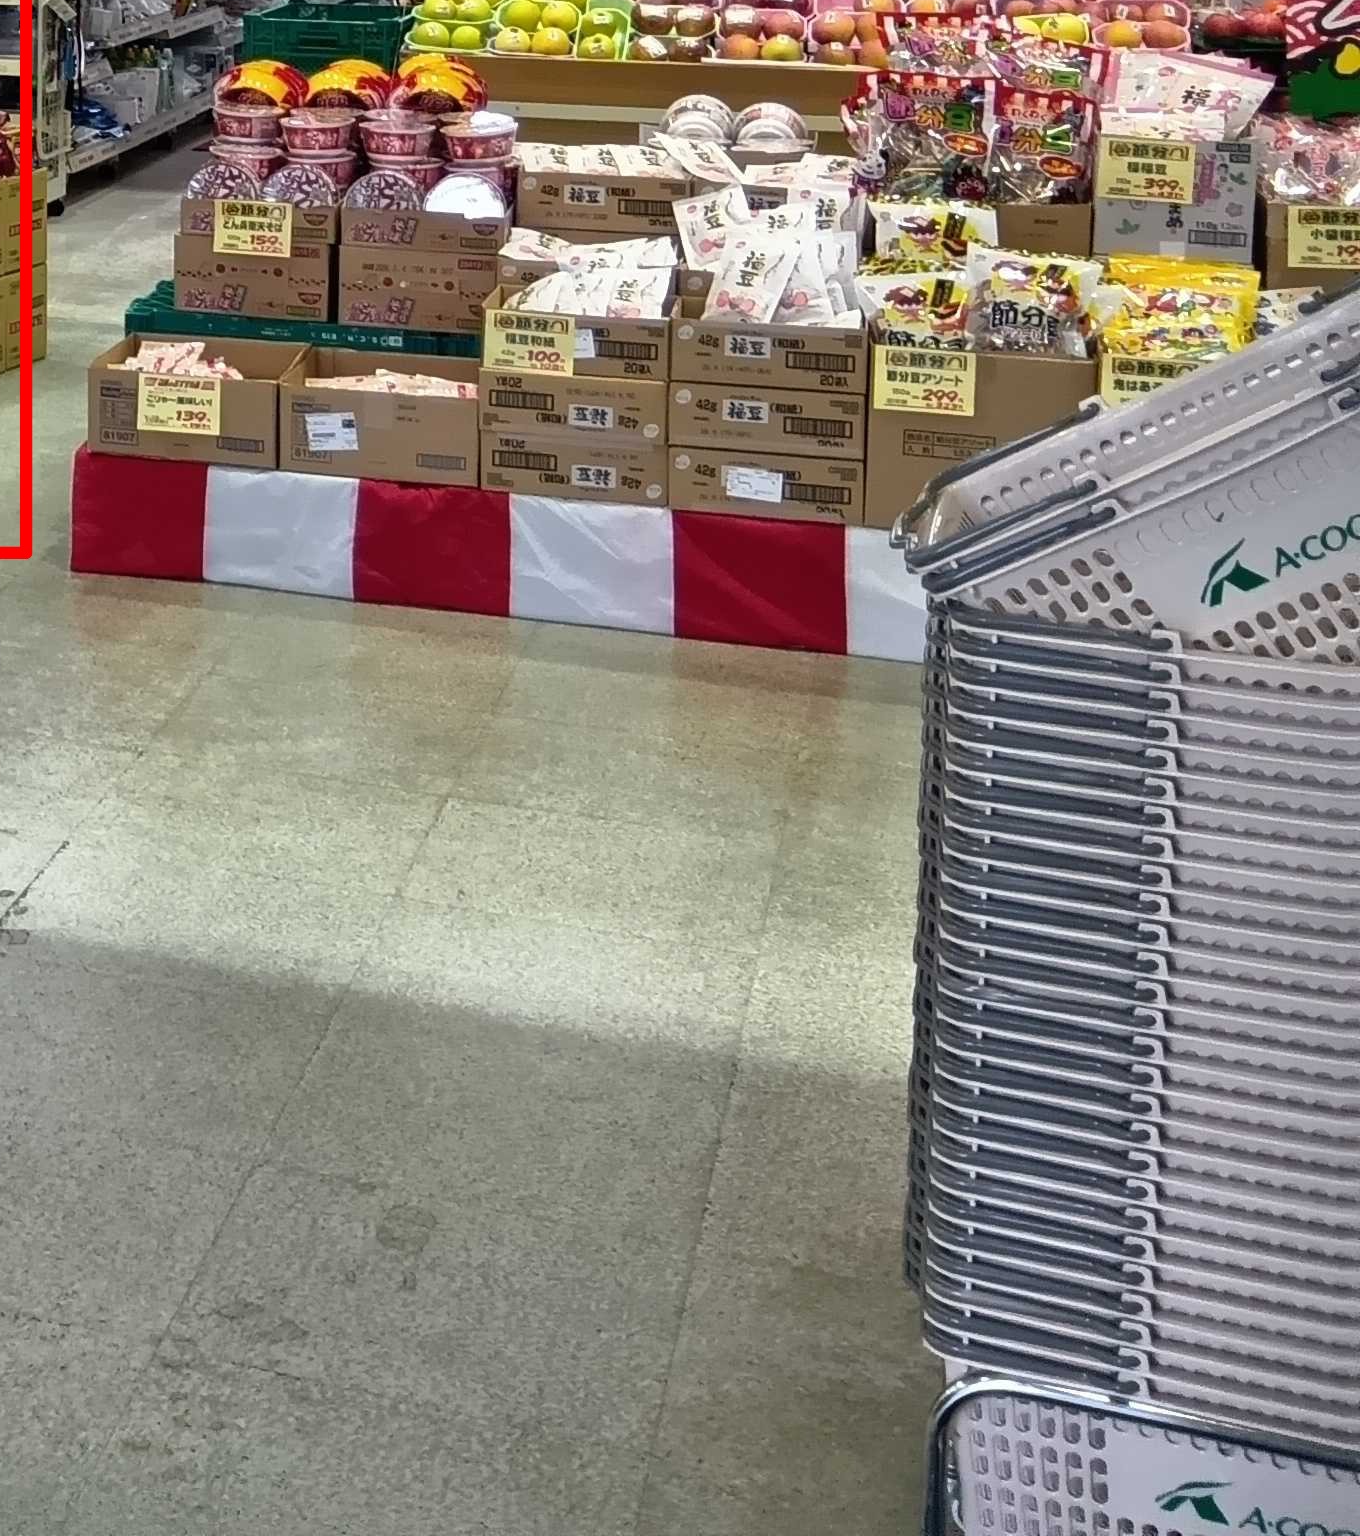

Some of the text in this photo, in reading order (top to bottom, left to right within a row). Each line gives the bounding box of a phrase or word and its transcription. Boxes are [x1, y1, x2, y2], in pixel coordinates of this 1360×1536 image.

[568, 187, 600, 204] 福豆
[729, 336, 767, 357] 福豆
[527, 350, 561, 364] 100
[921, 388, 959, 402] 299
[727, 401, 764, 421] 福豆
